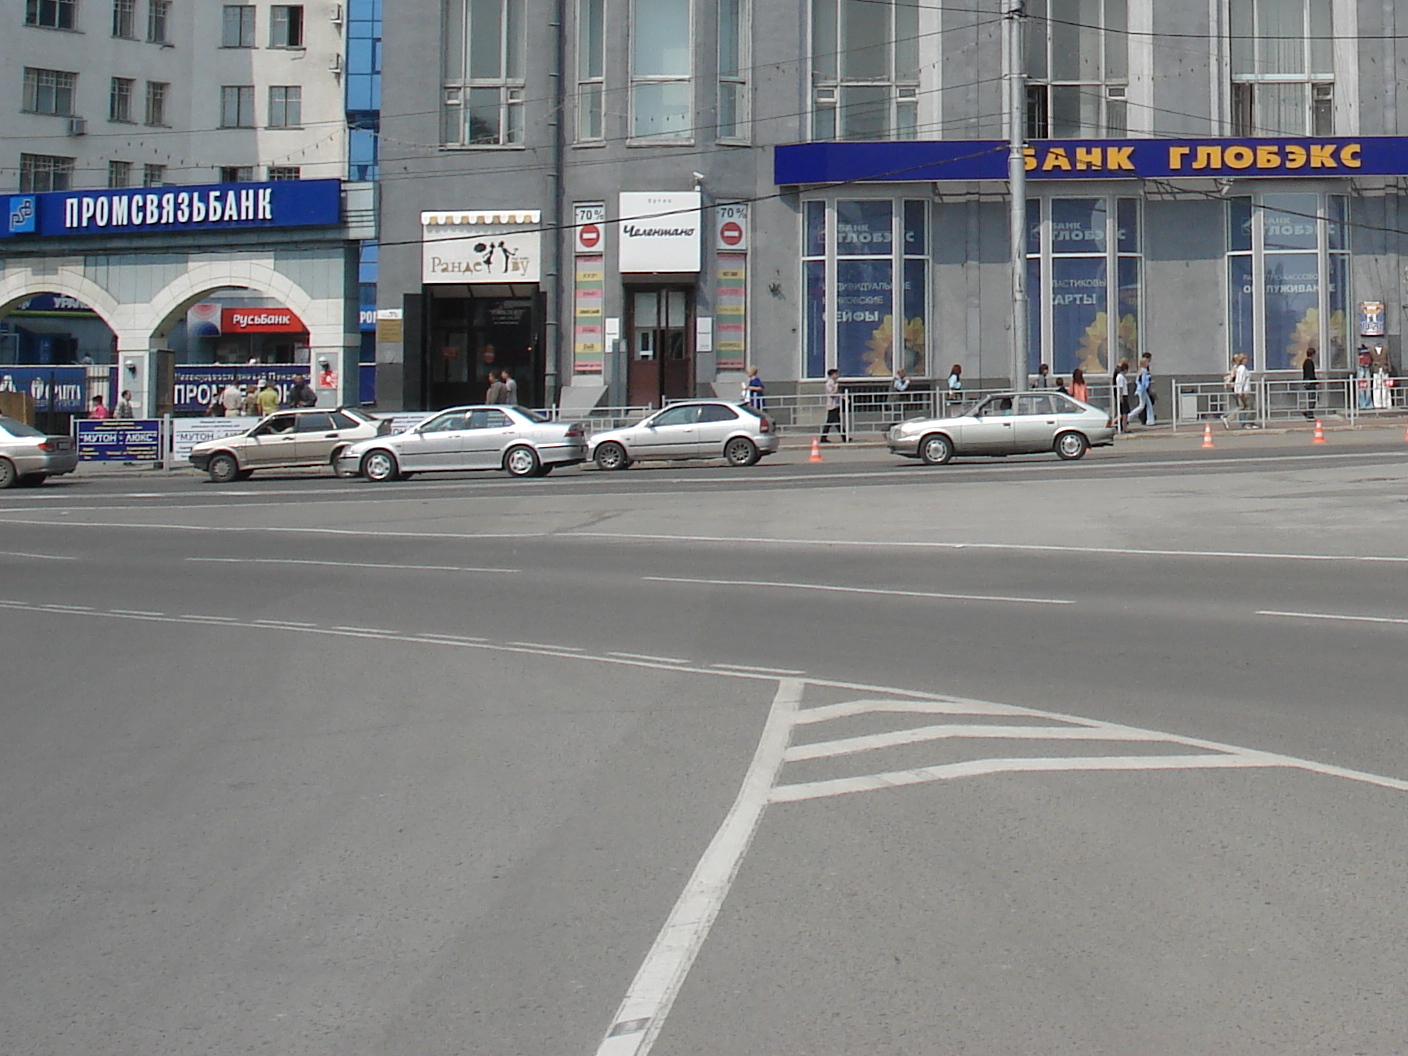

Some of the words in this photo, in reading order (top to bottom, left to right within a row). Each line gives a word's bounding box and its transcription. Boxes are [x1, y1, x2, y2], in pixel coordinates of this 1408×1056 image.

[1168, 143, 1362, 169] ГЛОБЭКС
[65, 187, 273, 229] ПРОМСВЯЗЬБАНК
[623, 224, 696, 238] Челентано
[837, 231, 915, 243] ГЛОБЭС
[1051, 230, 1127, 241] ГЛОБЭС
[1265, 225, 1335, 236] ЛОБЭС
